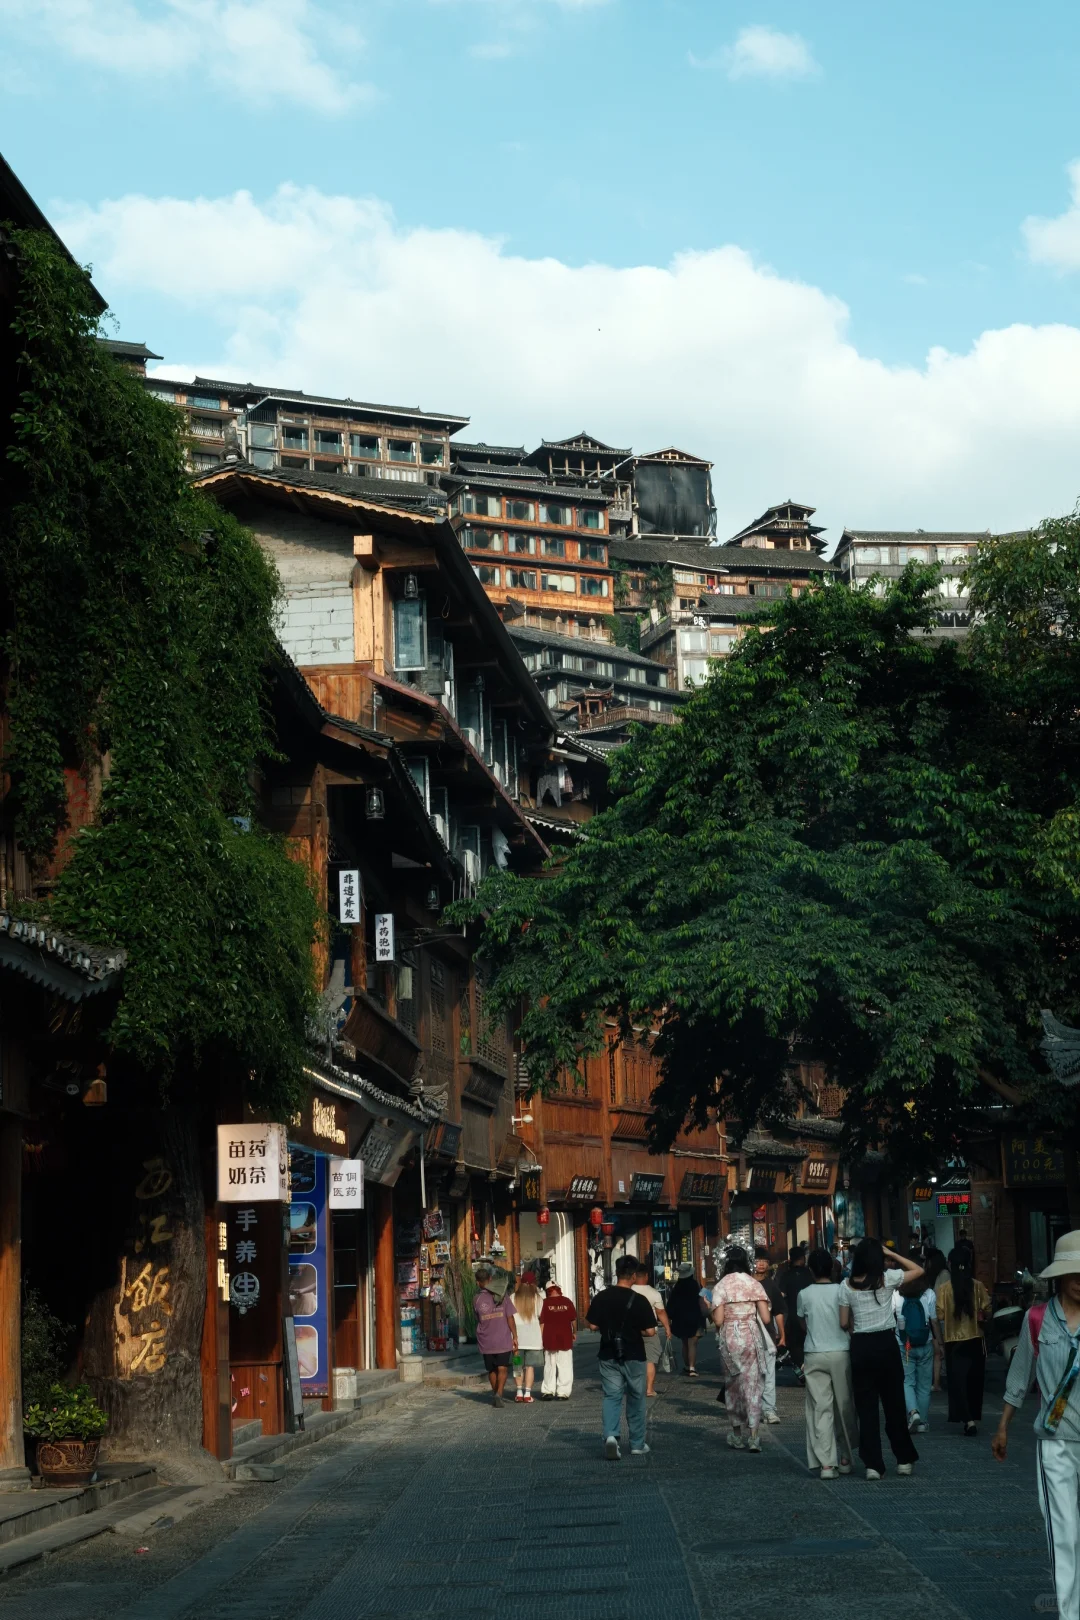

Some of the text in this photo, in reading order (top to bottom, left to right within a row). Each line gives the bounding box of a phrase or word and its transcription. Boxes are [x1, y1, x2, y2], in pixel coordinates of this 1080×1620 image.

[343, 873, 356, 920] 非遗养发
[378, 916, 391, 958] 中药泡脚
[228, 1140, 266, 1159] 苗药
[228, 1165, 266, 1185] 奶茶
[332, 1172, 357, 1182] 苗侗
[333, 1186, 358, 1197] 医药
